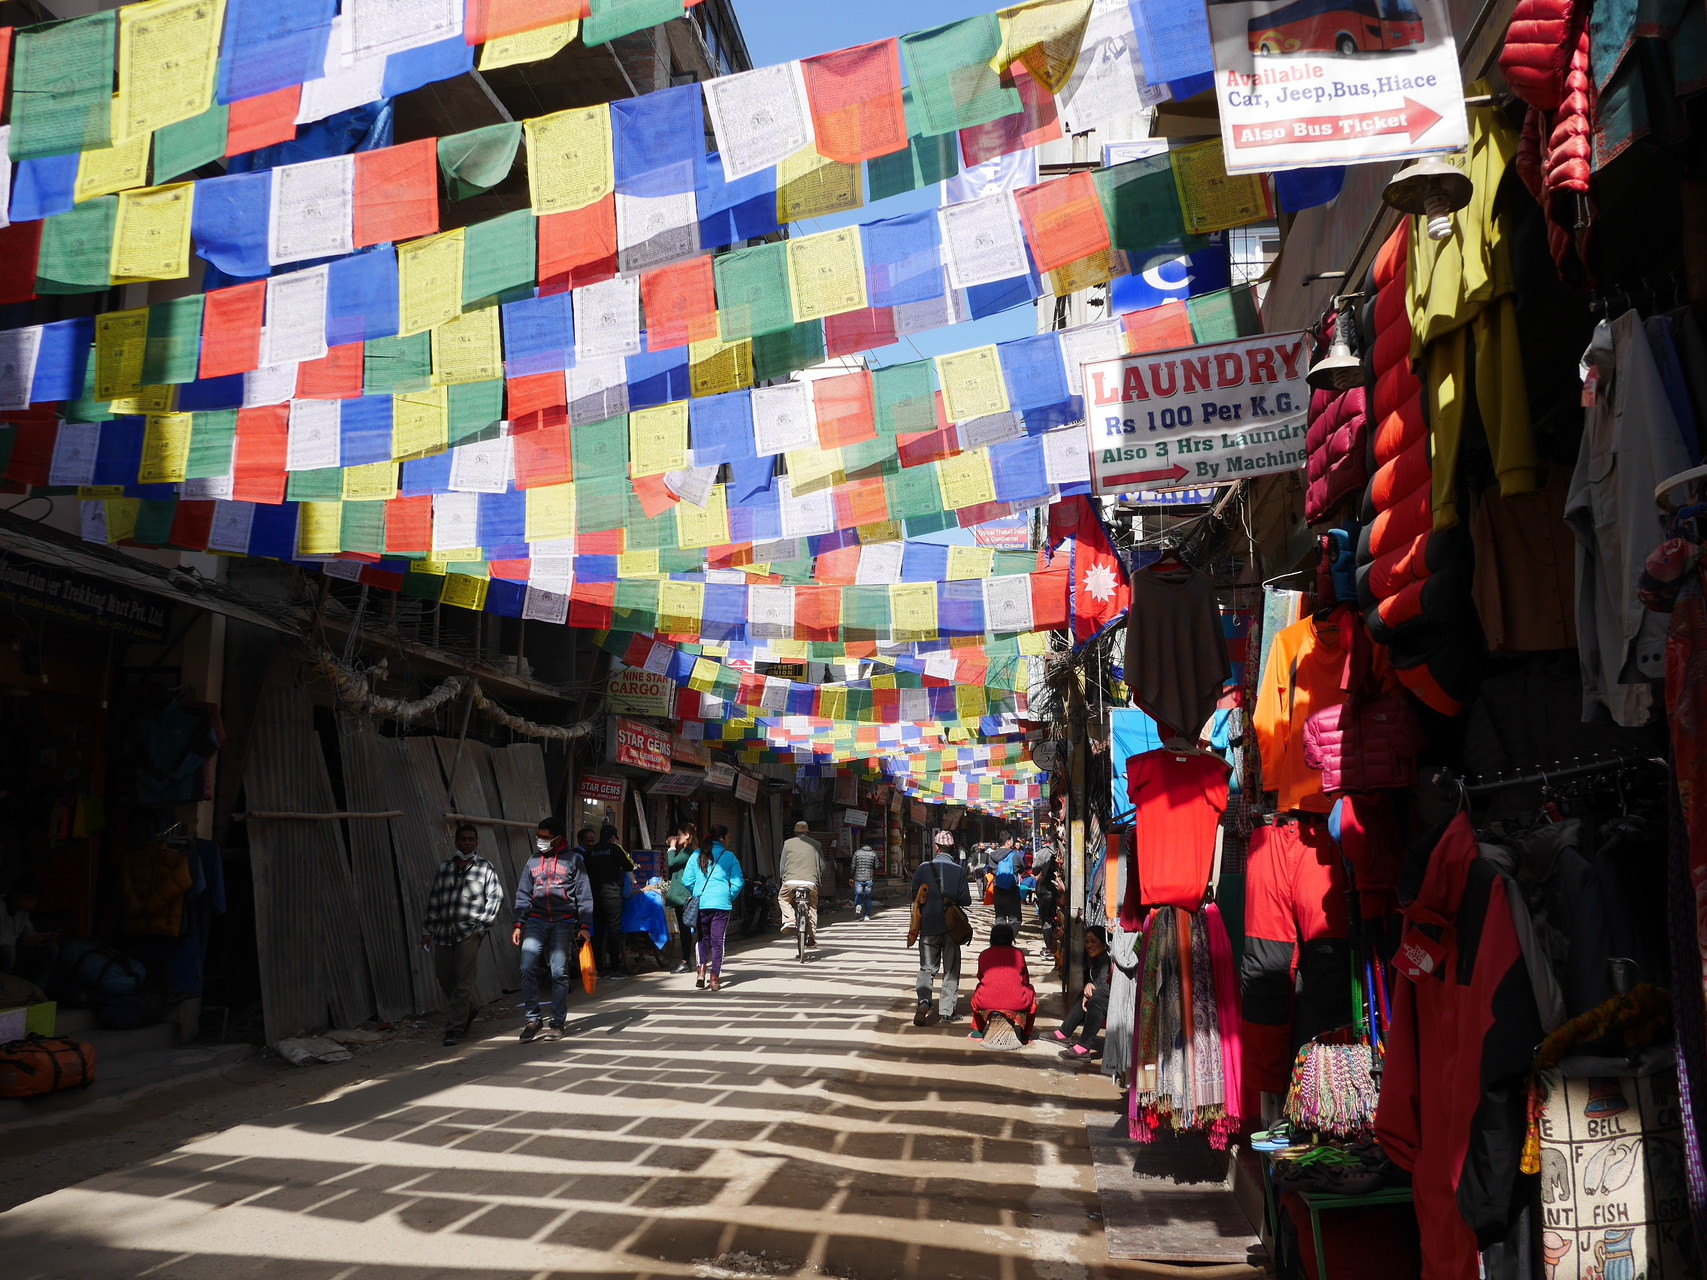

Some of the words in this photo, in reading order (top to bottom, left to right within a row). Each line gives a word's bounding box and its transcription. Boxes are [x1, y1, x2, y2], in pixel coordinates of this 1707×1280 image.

[1227, 63, 1324, 88] Available
[1228, 91, 1270, 109] Car,
[1241, 126, 1286, 144] Also
[1293, 121, 1333, 138] Bus
[1338, 113, 1409, 135] Ticket
[1091, 341, 1304, 407] LAUNDRY
[1105, 416, 1137, 437] Rs
[1147, 405, 1194, 432] 100
[1201, 402, 1243, 424] Per
[1250, 392, 1302, 418] K.G.
[1102, 447, 1148, 464] Also
[1155, 441, 1169, 457] 3
[1177, 437, 1214, 455] Hrs
[1222, 422, 1308, 450] Laundry
[1195, 461, 1220, 479] By
[1226, 449, 1308, 473] Machine
[62, 579, 107, 615] Trekking
[609, 681, 660, 696] CARGO
[622, 671, 644, 682] NINE
[646, 672, 669, 684] STAR
[618, 729, 645, 749] STAR
[647, 738, 671, 757] GEMS
[581, 781, 600, 793] STAR
[600, 784, 621, 796] GEMS
[1414, 944, 1427, 956] THE
[1587, 1117, 1627, 1138] BELL
[1574, 1145, 1584, 1164] F
[1593, 1203, 1630, 1225] FISH
[1580, 1231, 1592, 1252] J
